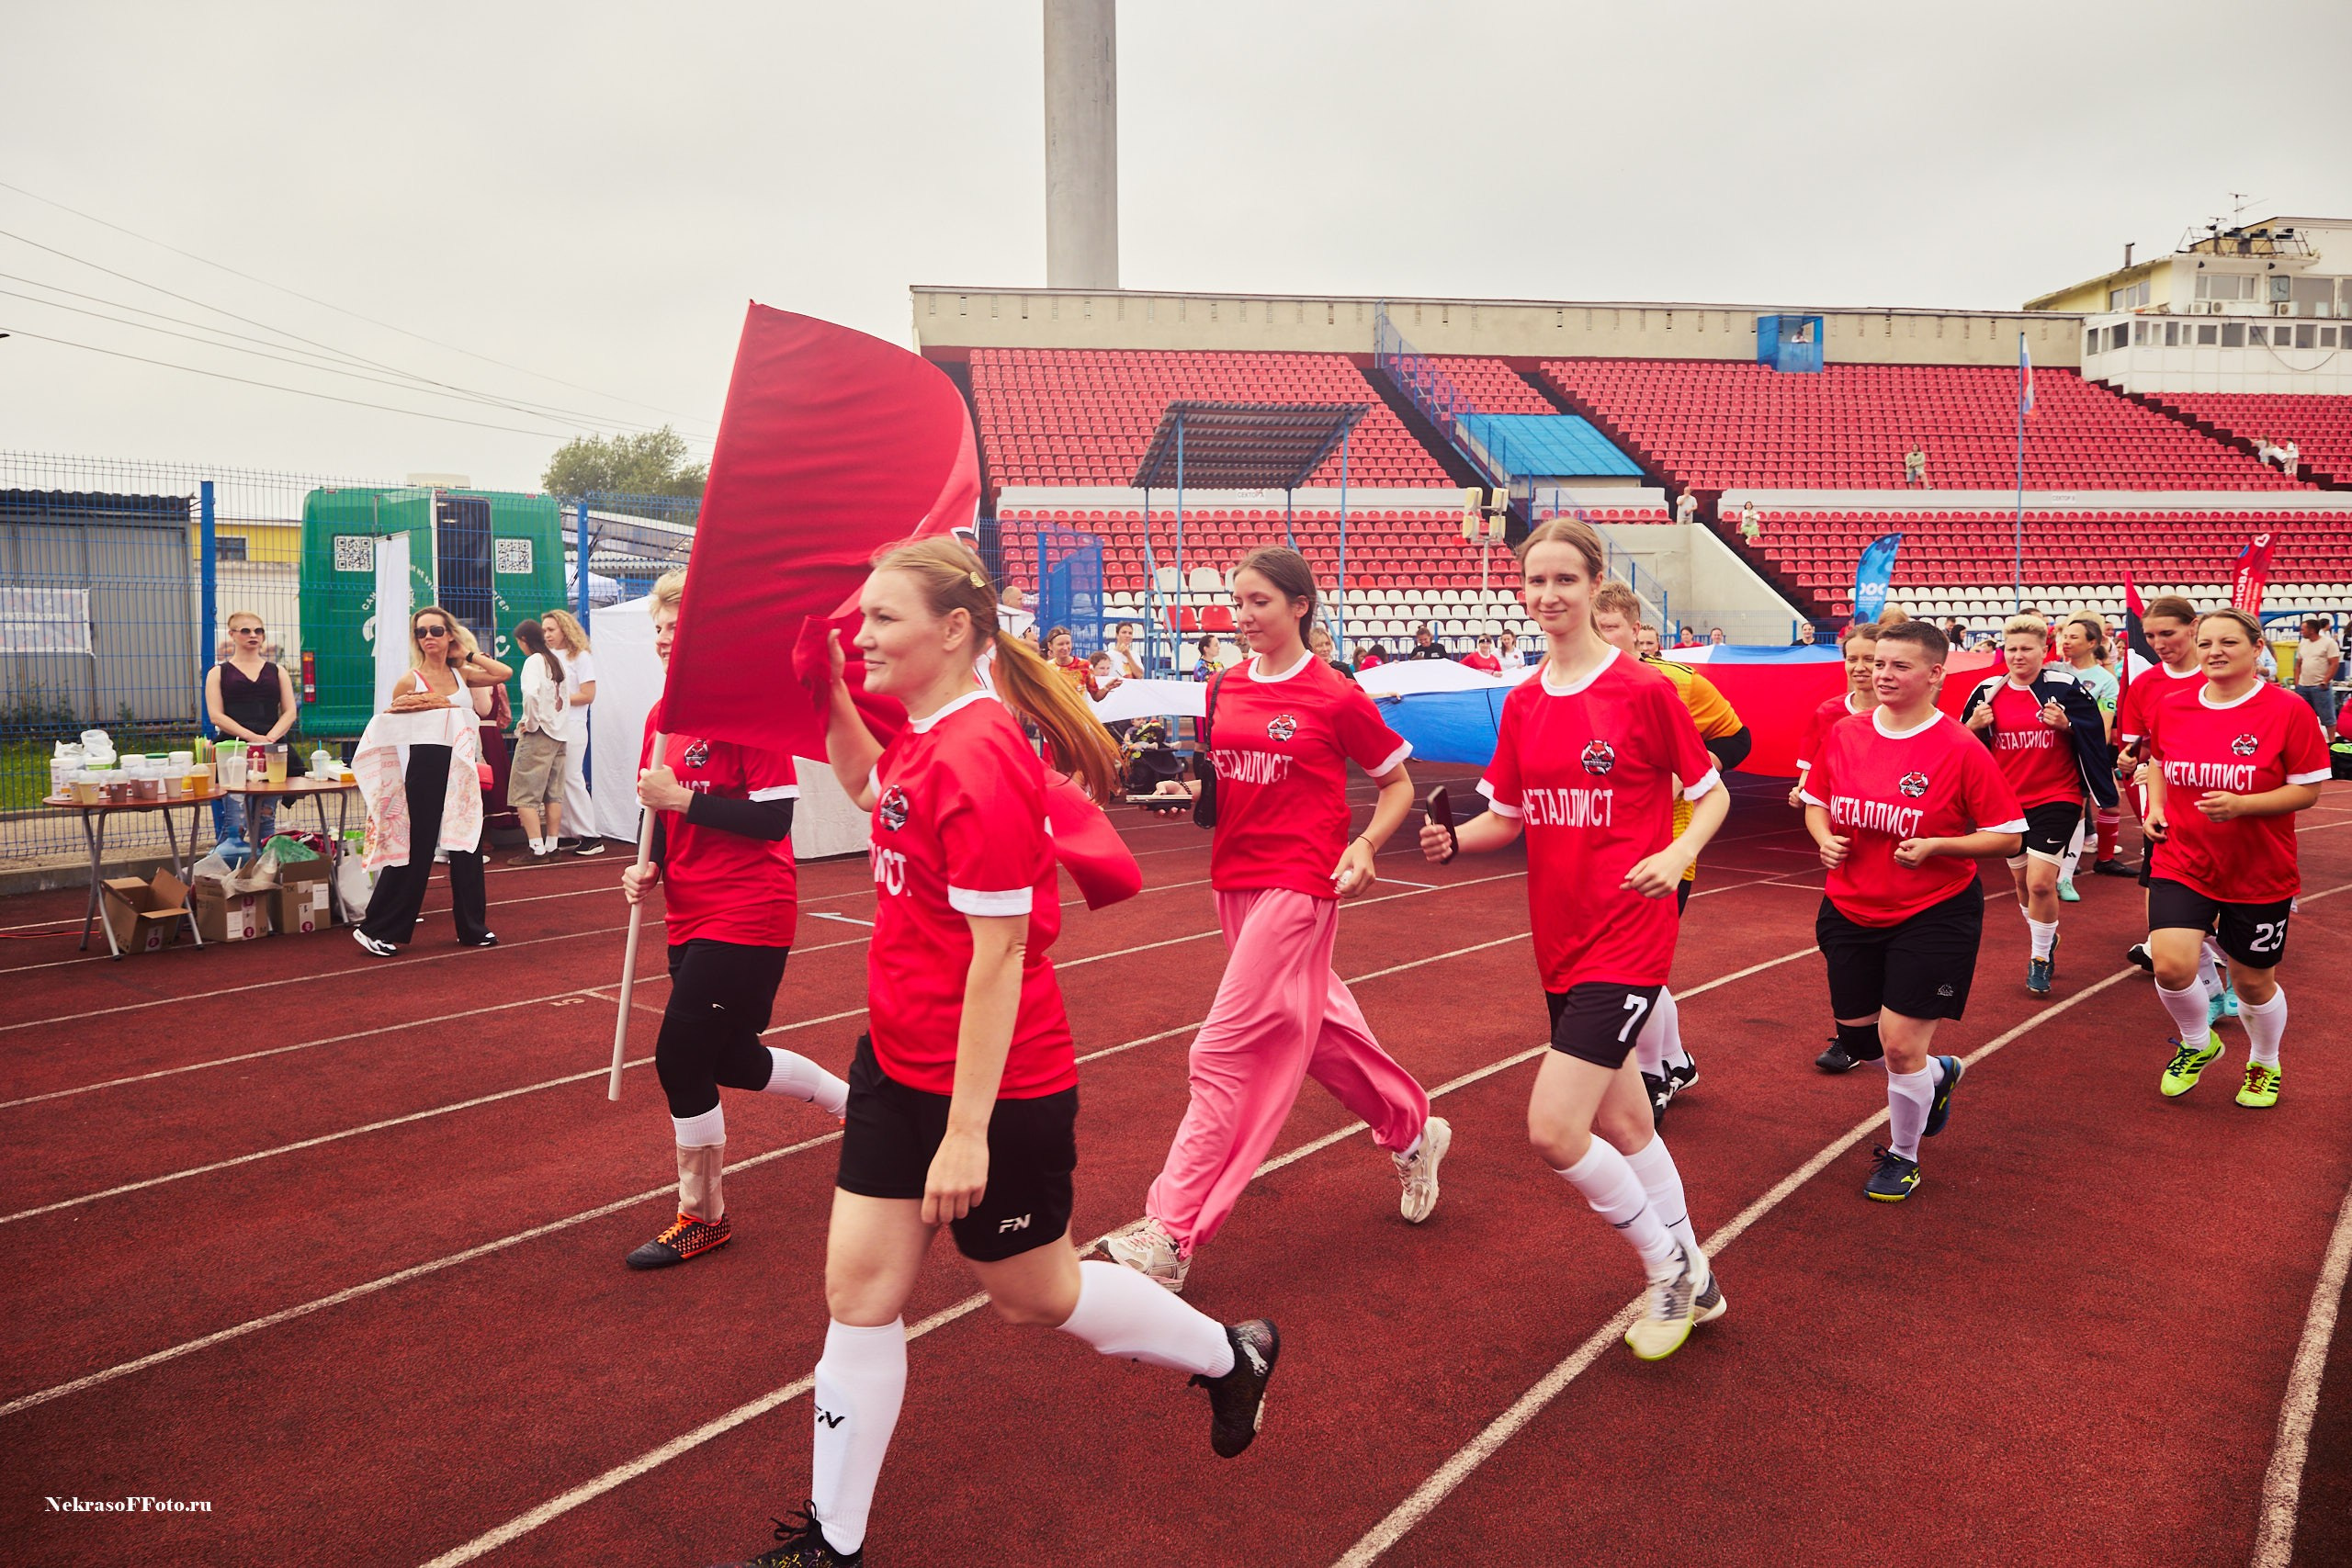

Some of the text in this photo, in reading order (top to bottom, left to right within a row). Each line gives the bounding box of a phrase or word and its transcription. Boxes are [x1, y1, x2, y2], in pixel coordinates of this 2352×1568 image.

[2233, 566, 2251, 610] СНОВА
[1995, 729, 2055, 750] МЕТАЛЛИСТ
[2164, 760, 2256, 791] МЕТАЛЛИСТ
[1830, 795, 1924, 838] МЕТАЛЛИСТ
[2249, 919, 2287, 952] 23
[1617, 993, 1648, 1043] 7
